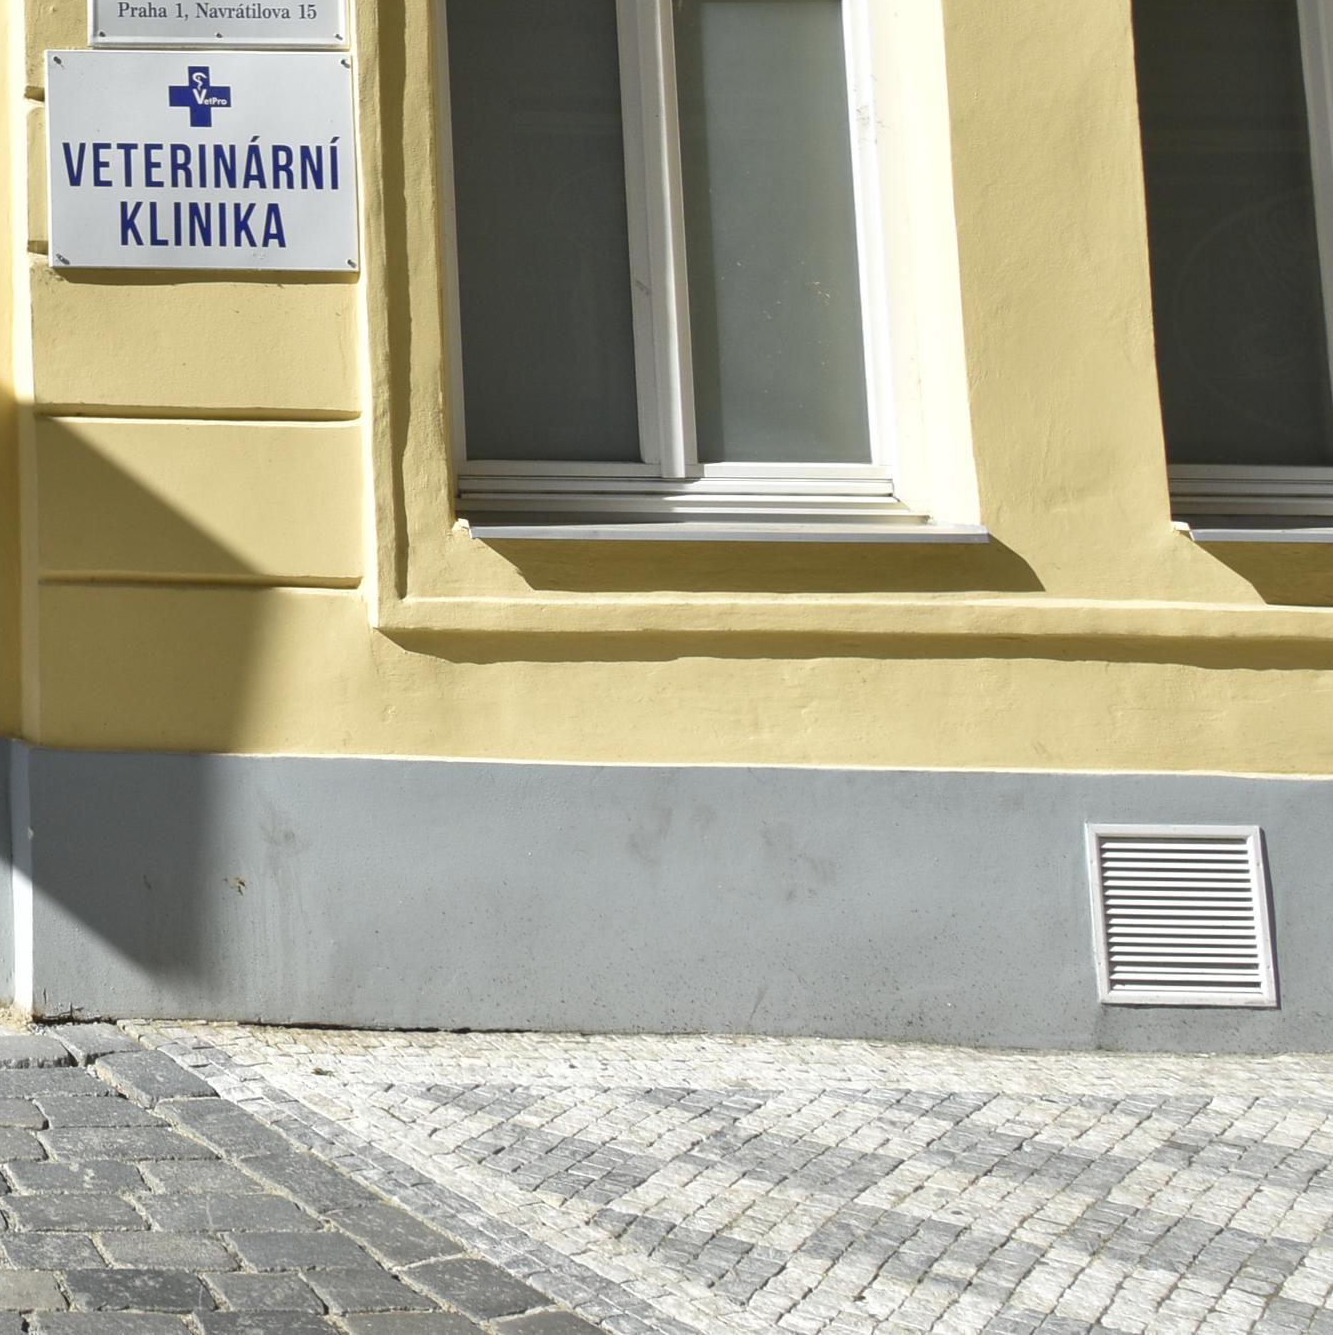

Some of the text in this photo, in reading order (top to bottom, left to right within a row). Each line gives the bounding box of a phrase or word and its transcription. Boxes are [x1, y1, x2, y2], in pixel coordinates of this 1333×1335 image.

[118, 2, 317, 20] Praha 1, Navrátilova 15
[193, 88, 227, 105] VetPro
[62, 136, 340, 190] VETERINÁRNÍ
[120, 201, 287, 248] KLINIKA
